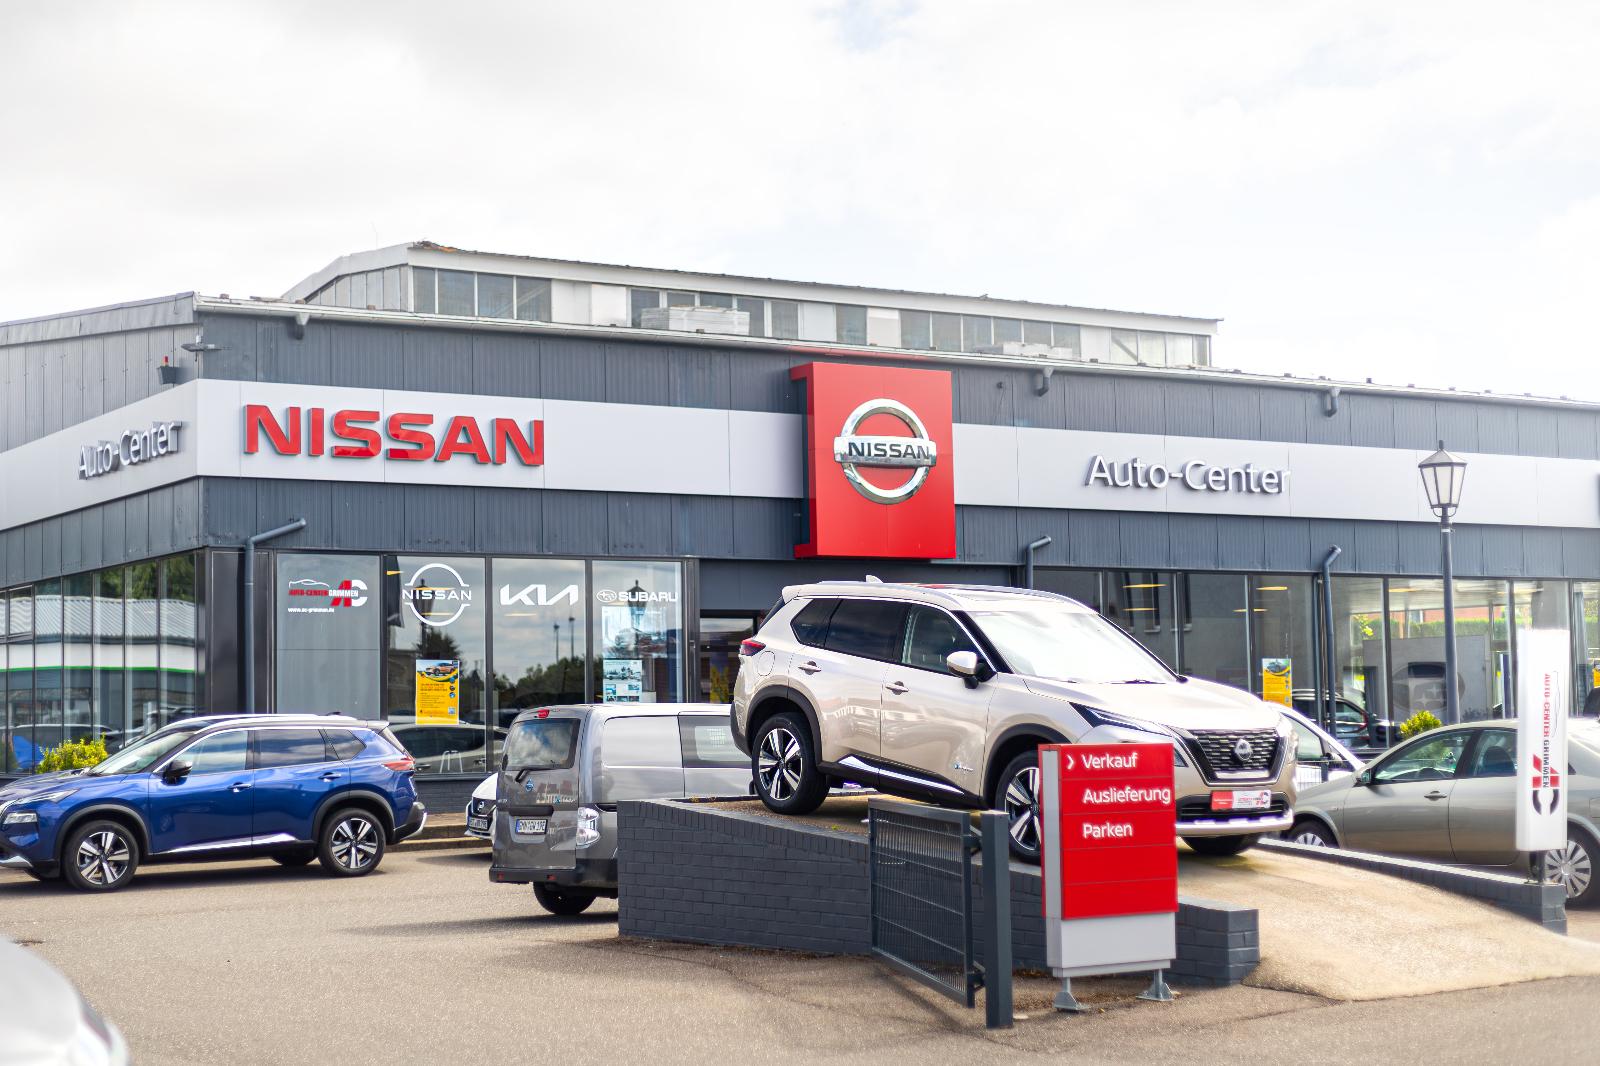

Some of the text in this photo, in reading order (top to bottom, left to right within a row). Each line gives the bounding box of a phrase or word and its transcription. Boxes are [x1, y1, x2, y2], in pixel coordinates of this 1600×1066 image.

[244, 403, 544, 466] NISSAN
[78, 420, 182, 480] Auto-Center
[848, 442, 930, 460] NISSAN
[1084, 454, 1291, 494] Auto-Center
[402, 589, 472, 601] NISSAN
[500, 584, 579, 606] KIA
[618, 591, 679, 602] SUBARU
[1081, 751, 1138, 769] Verkauf
[1542, 739, 1550, 788] GRIMMEN
[1082, 786, 1171, 805] Auslieferung
[1082, 821, 1133, 839] Parken
